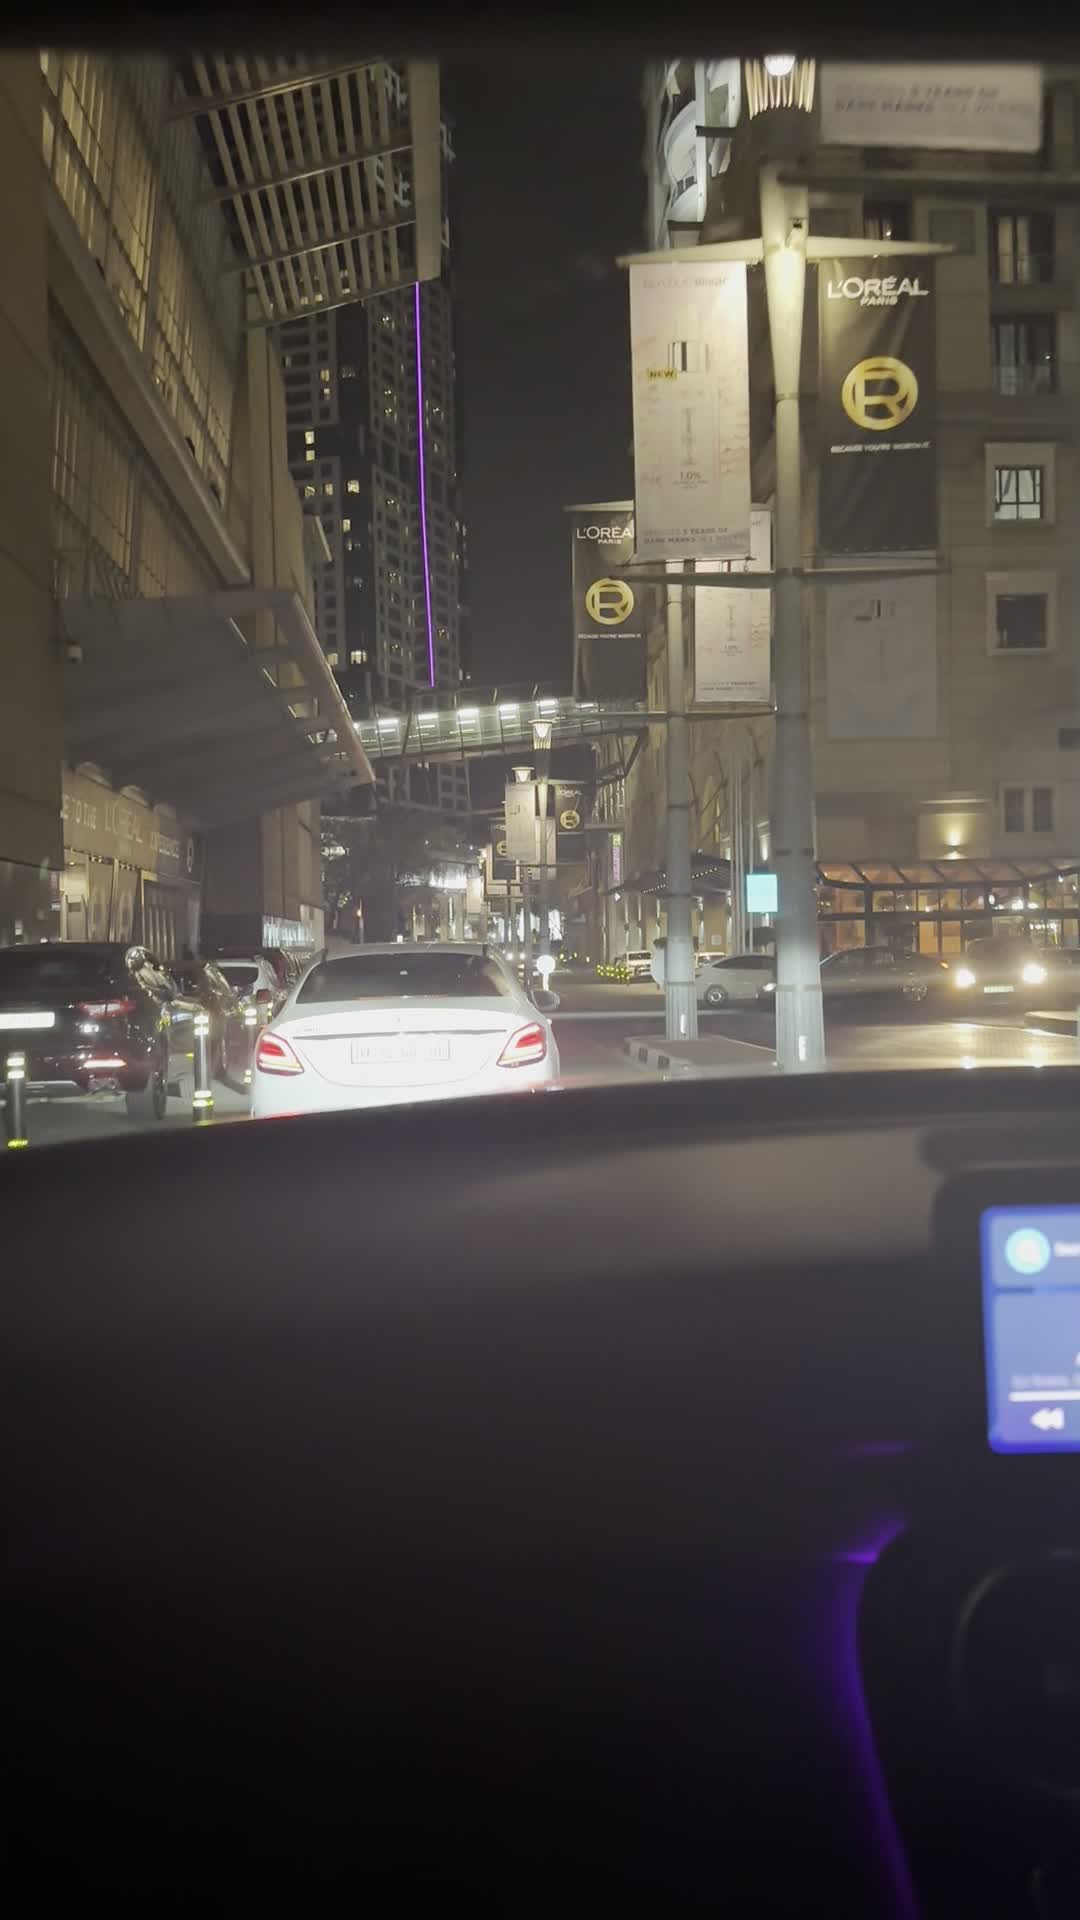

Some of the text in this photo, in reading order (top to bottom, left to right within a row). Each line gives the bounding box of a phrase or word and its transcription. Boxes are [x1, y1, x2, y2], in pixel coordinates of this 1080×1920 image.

[827, 275, 930, 299] L'ORÉAL
[860, 295, 899, 307] PARIS
[576, 526, 634, 539] L'ORÉA
